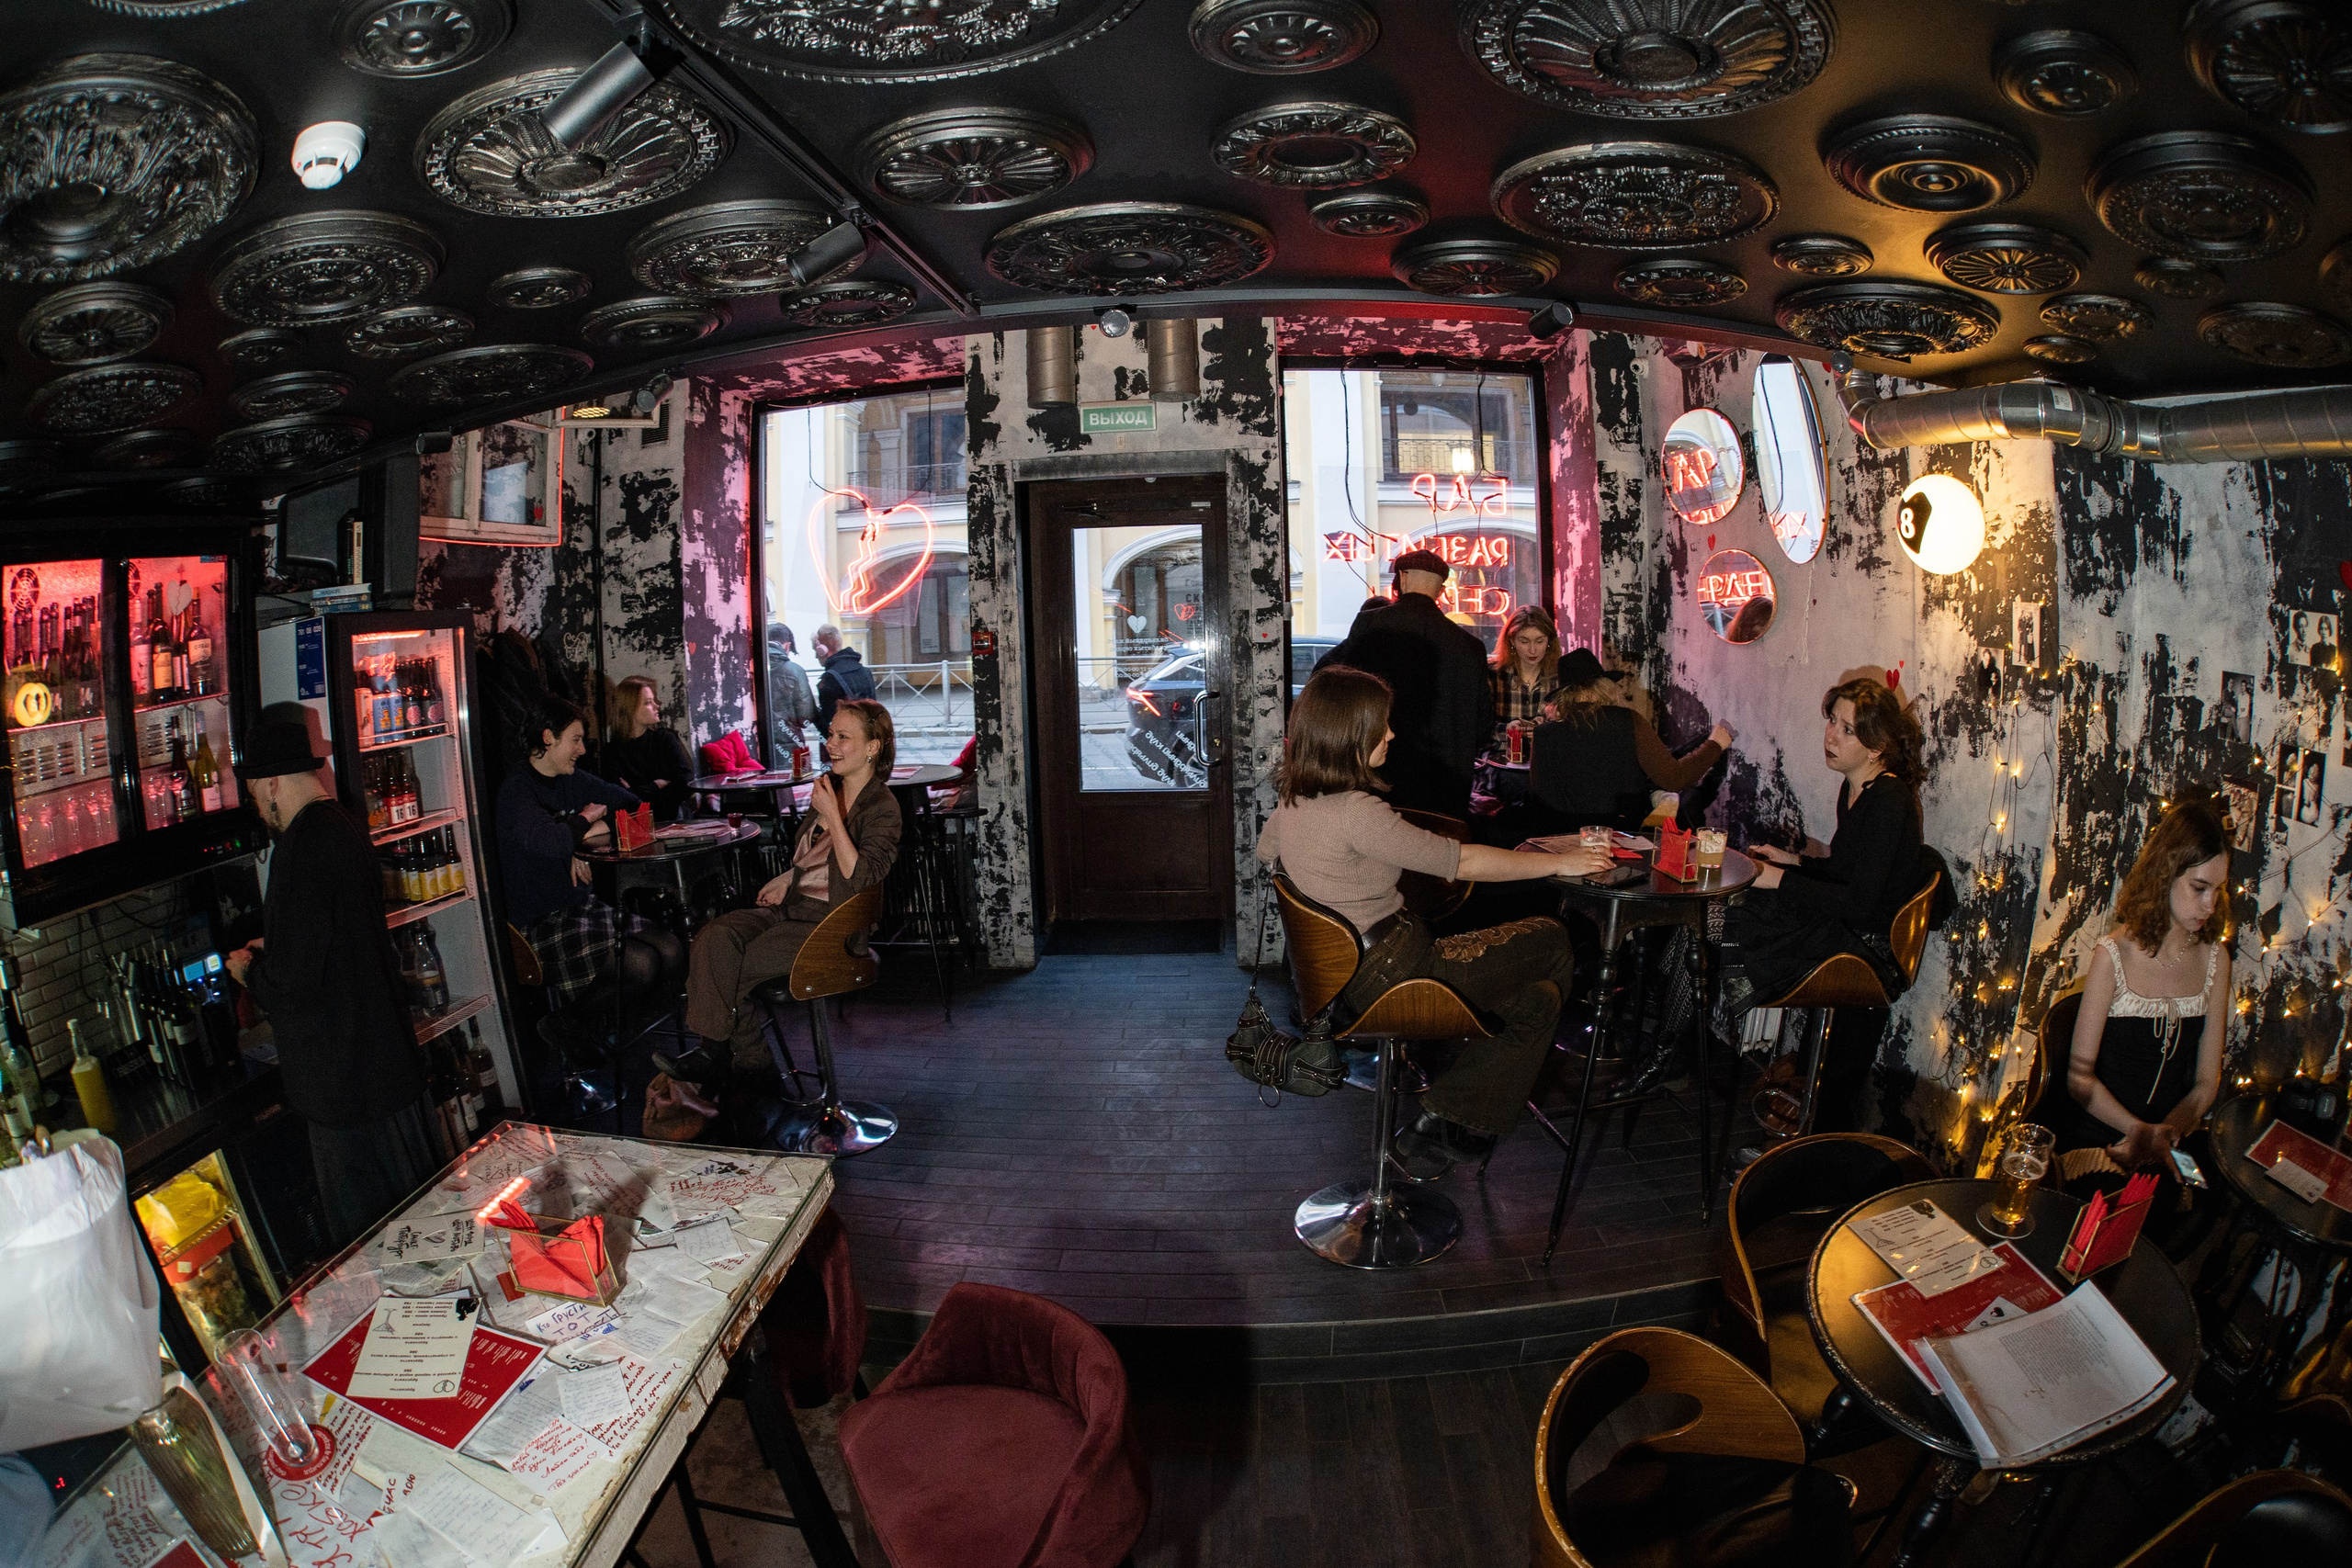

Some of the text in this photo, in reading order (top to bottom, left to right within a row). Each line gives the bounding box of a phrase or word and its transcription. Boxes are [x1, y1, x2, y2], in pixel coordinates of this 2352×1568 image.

[1089, 408, 1148, 426] ВЫХОД
[1900, 508, 1916, 539] 8
[395, 807, 404, 820] 16
[407, 805, 416, 818] 16
[552, 1302, 588, 1324] Грусти
